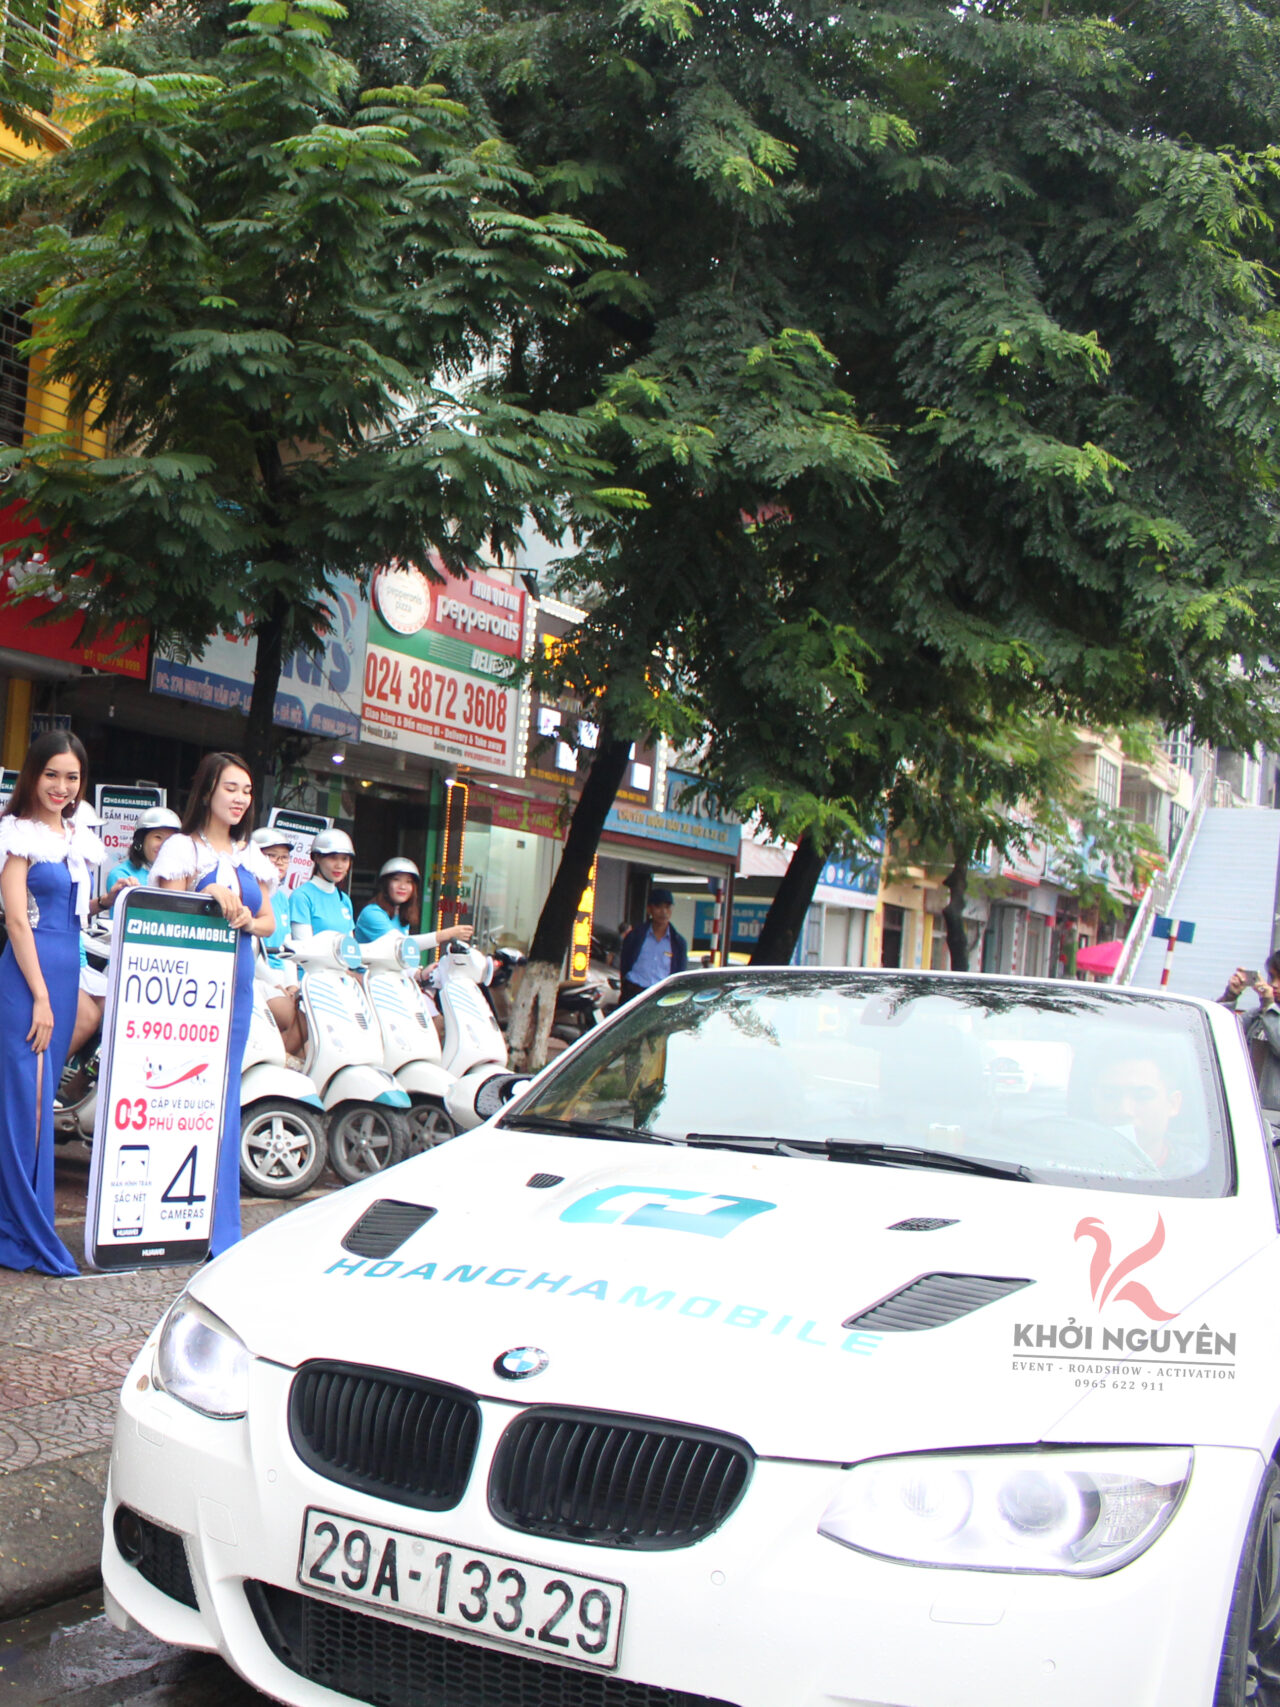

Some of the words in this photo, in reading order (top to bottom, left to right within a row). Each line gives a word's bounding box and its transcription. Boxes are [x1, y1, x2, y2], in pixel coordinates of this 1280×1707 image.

[436, 595, 520, 641] pepperonis
[365, 651, 402, 704] 024
[408, 666, 458, 720] 3872
[463, 682, 508, 733] 3608
[104, 835, 119, 847] 03
[142, 921, 236, 944] HOANGHAMOBILE
[128, 956, 189, 975] HUAWEI
[125, 974, 198, 1007] nova
[205, 981, 226, 1009] 2i
[126, 1020, 220, 1042] 5.990.000Đ
[114, 1098, 148, 1131] 03
[184, 1099, 195, 1109] DU
[148, 1113, 173, 1131] PHÚ
[178, 1112, 214, 1131] QUỐC
[161, 1145, 206, 1203] 4
[160, 1208, 205, 1220] CAMERAS
[142, 1248, 166, 1257] HUAWEI
[322, 1258, 885, 1356] HOANGHAMOBILE
[309, 1521, 613, 1654] 29A-133.29
